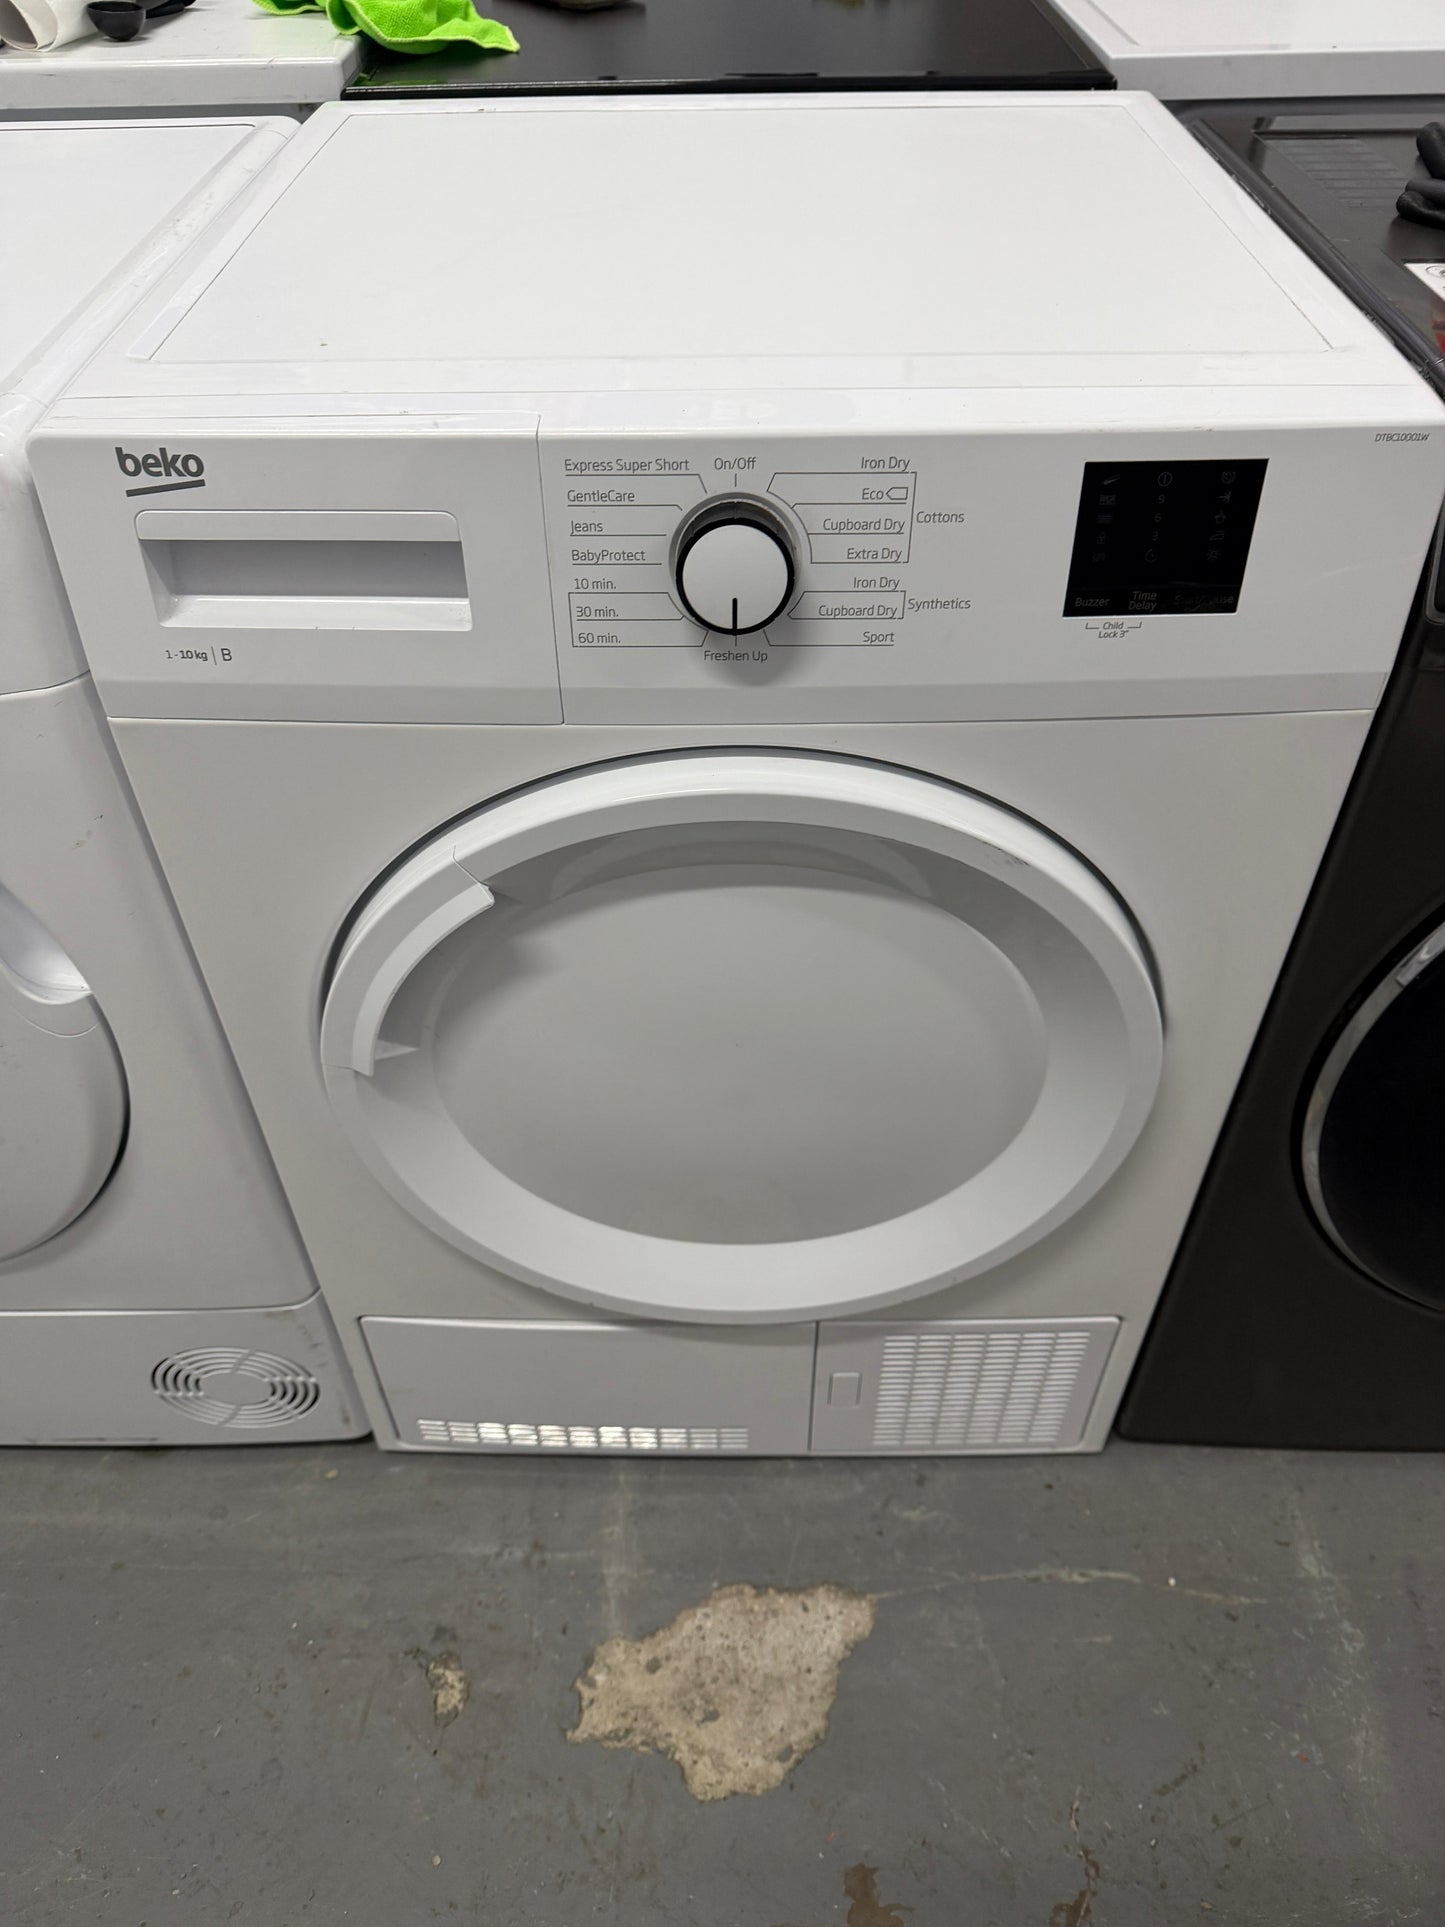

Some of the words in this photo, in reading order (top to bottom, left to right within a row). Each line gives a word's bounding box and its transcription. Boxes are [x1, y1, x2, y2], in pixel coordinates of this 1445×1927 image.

[115, 447, 205, 478] beko
[564, 459, 614, 473] Express
[616, 459, 652, 473] Super
[655, 458, 690, 471] Short
[714, 457, 756, 470] On/Off
[860, 457, 886, 469] Iron
[888, 457, 910, 472] Dry
[567, 490, 636, 502] GentleCare
[862, 488, 884, 500] Eco
[916, 511, 965, 524] Cottons
[570, 520, 604, 534] Jeans
[822, 518, 881, 534] Cupboard
[884, 518, 905, 534] Dry
[571, 550, 646, 564] BabyProtect
[846, 548, 879, 560] Extra
[881, 548, 903, 563] Dry
[574, 578, 589, 590] 10
[592, 578, 617, 590] min.
[853, 577, 876, 588] Iron
[880, 577, 900, 591] Dry
[1132, 590, 1157, 600] Time
[907, 598, 971, 612] Synthetics
[1075, 597, 1110, 607] Buzzer
[1128, 600, 1158, 611] Delay
[576, 606, 592, 618] 30
[594, 606, 619, 618] min.
[818, 605, 876, 619] Cupboard
[878, 605, 898, 619] Dry
[1102, 622, 1124, 630] Child
[578, 632, 594, 644] 60
[597, 632, 621, 644] min.
[862, 631, 895, 644] Sport
[1098, 630, 1118, 638] Lock
[220, 648, 232, 662] B
[704, 650, 750, 662] Freshen
[752, 650, 768, 663] Up
